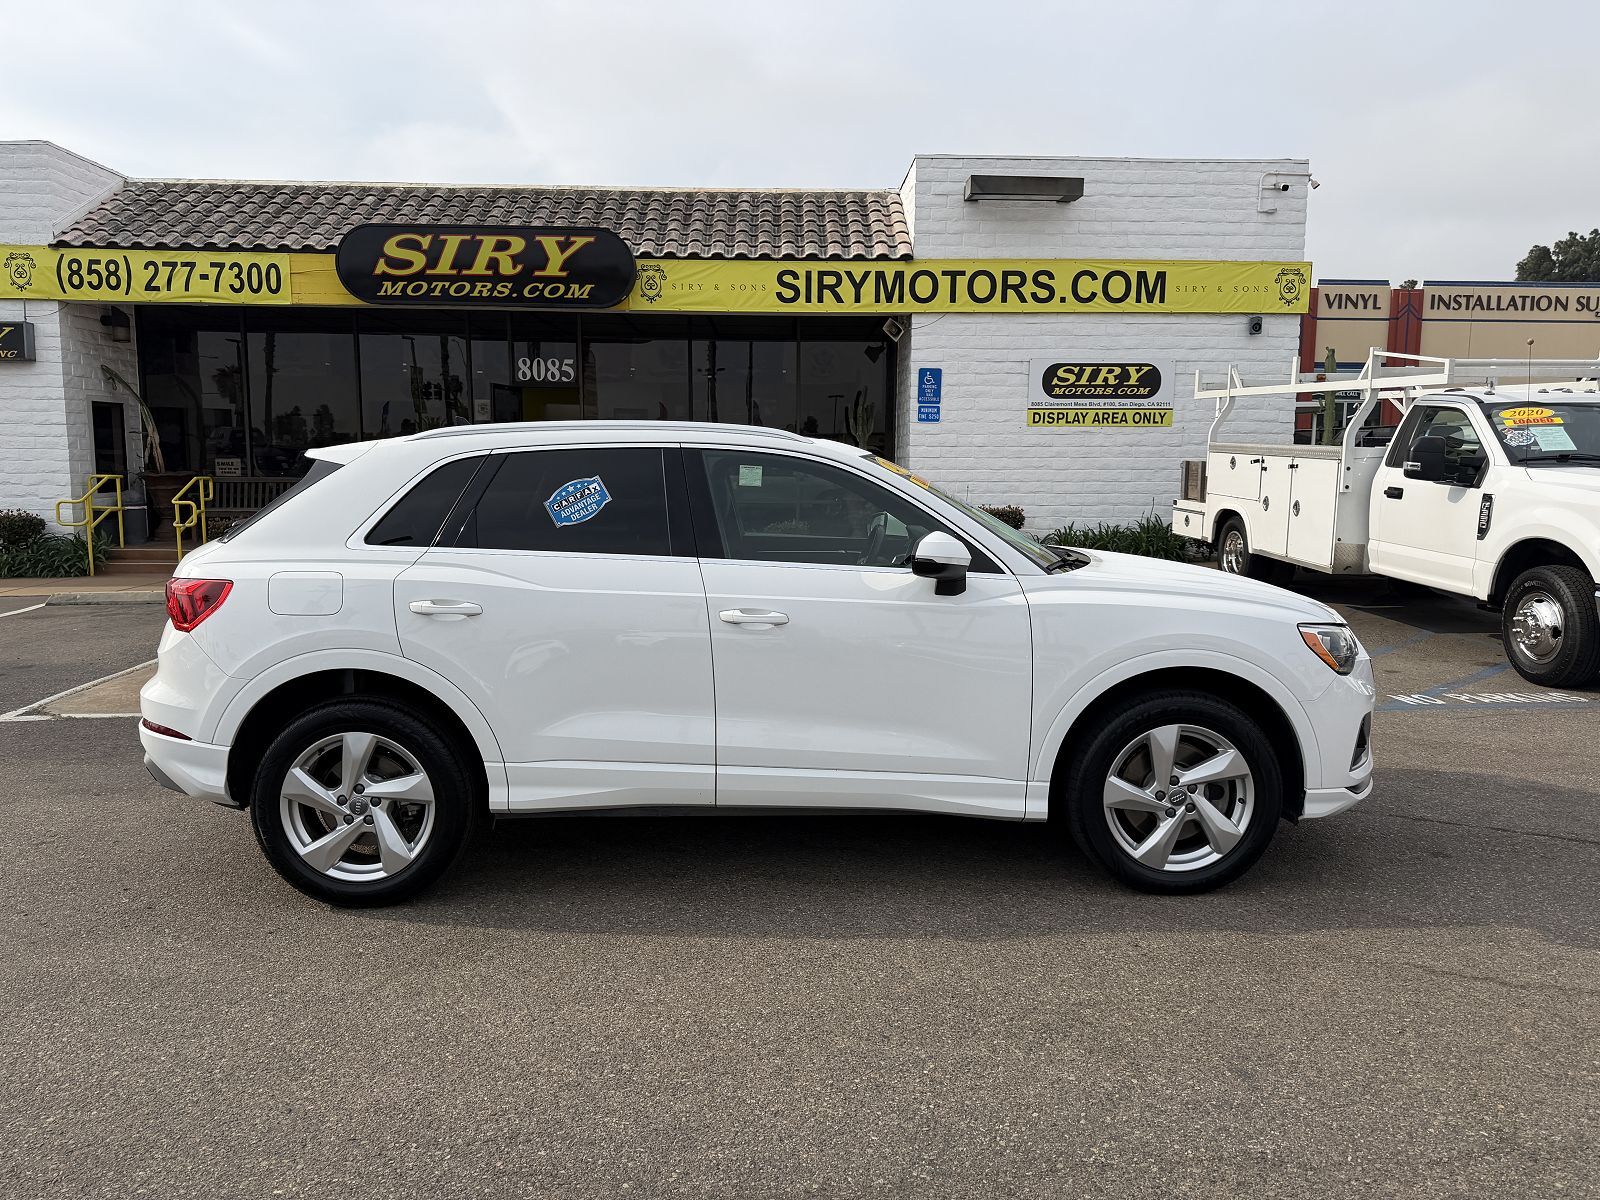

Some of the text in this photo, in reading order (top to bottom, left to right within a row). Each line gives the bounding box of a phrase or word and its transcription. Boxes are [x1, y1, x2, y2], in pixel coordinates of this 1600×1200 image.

[373, 233, 597, 278] SIRY
[56, 253, 282, 296] (858) 277-7300
[377, 281, 595, 299] MOTORS.COM
[671, 283, 704, 291] SIRY
[730, 283, 767, 291] SONS
[775, 269, 1166, 304] SIRYMOTORS.COM
[1175, 285, 1269, 293] SIRY & SONS
[1325, 293, 1382, 310] VINYL
[1430, 294, 1569, 311] INSTALLATION
[517, 357, 575, 382] 8085
[1051, 366, 1153, 386] SIRY
[1051, 387, 1152, 395] MOTORS.COM
[1032, 412, 1167, 424] DISPLAY AREA ONLY
[1509, 408, 1544, 418] 2020
[552, 484, 600, 512] CARFAX
[560, 493, 601, 518] ADVANTAGE
[570, 503, 599, 521] DEALER
